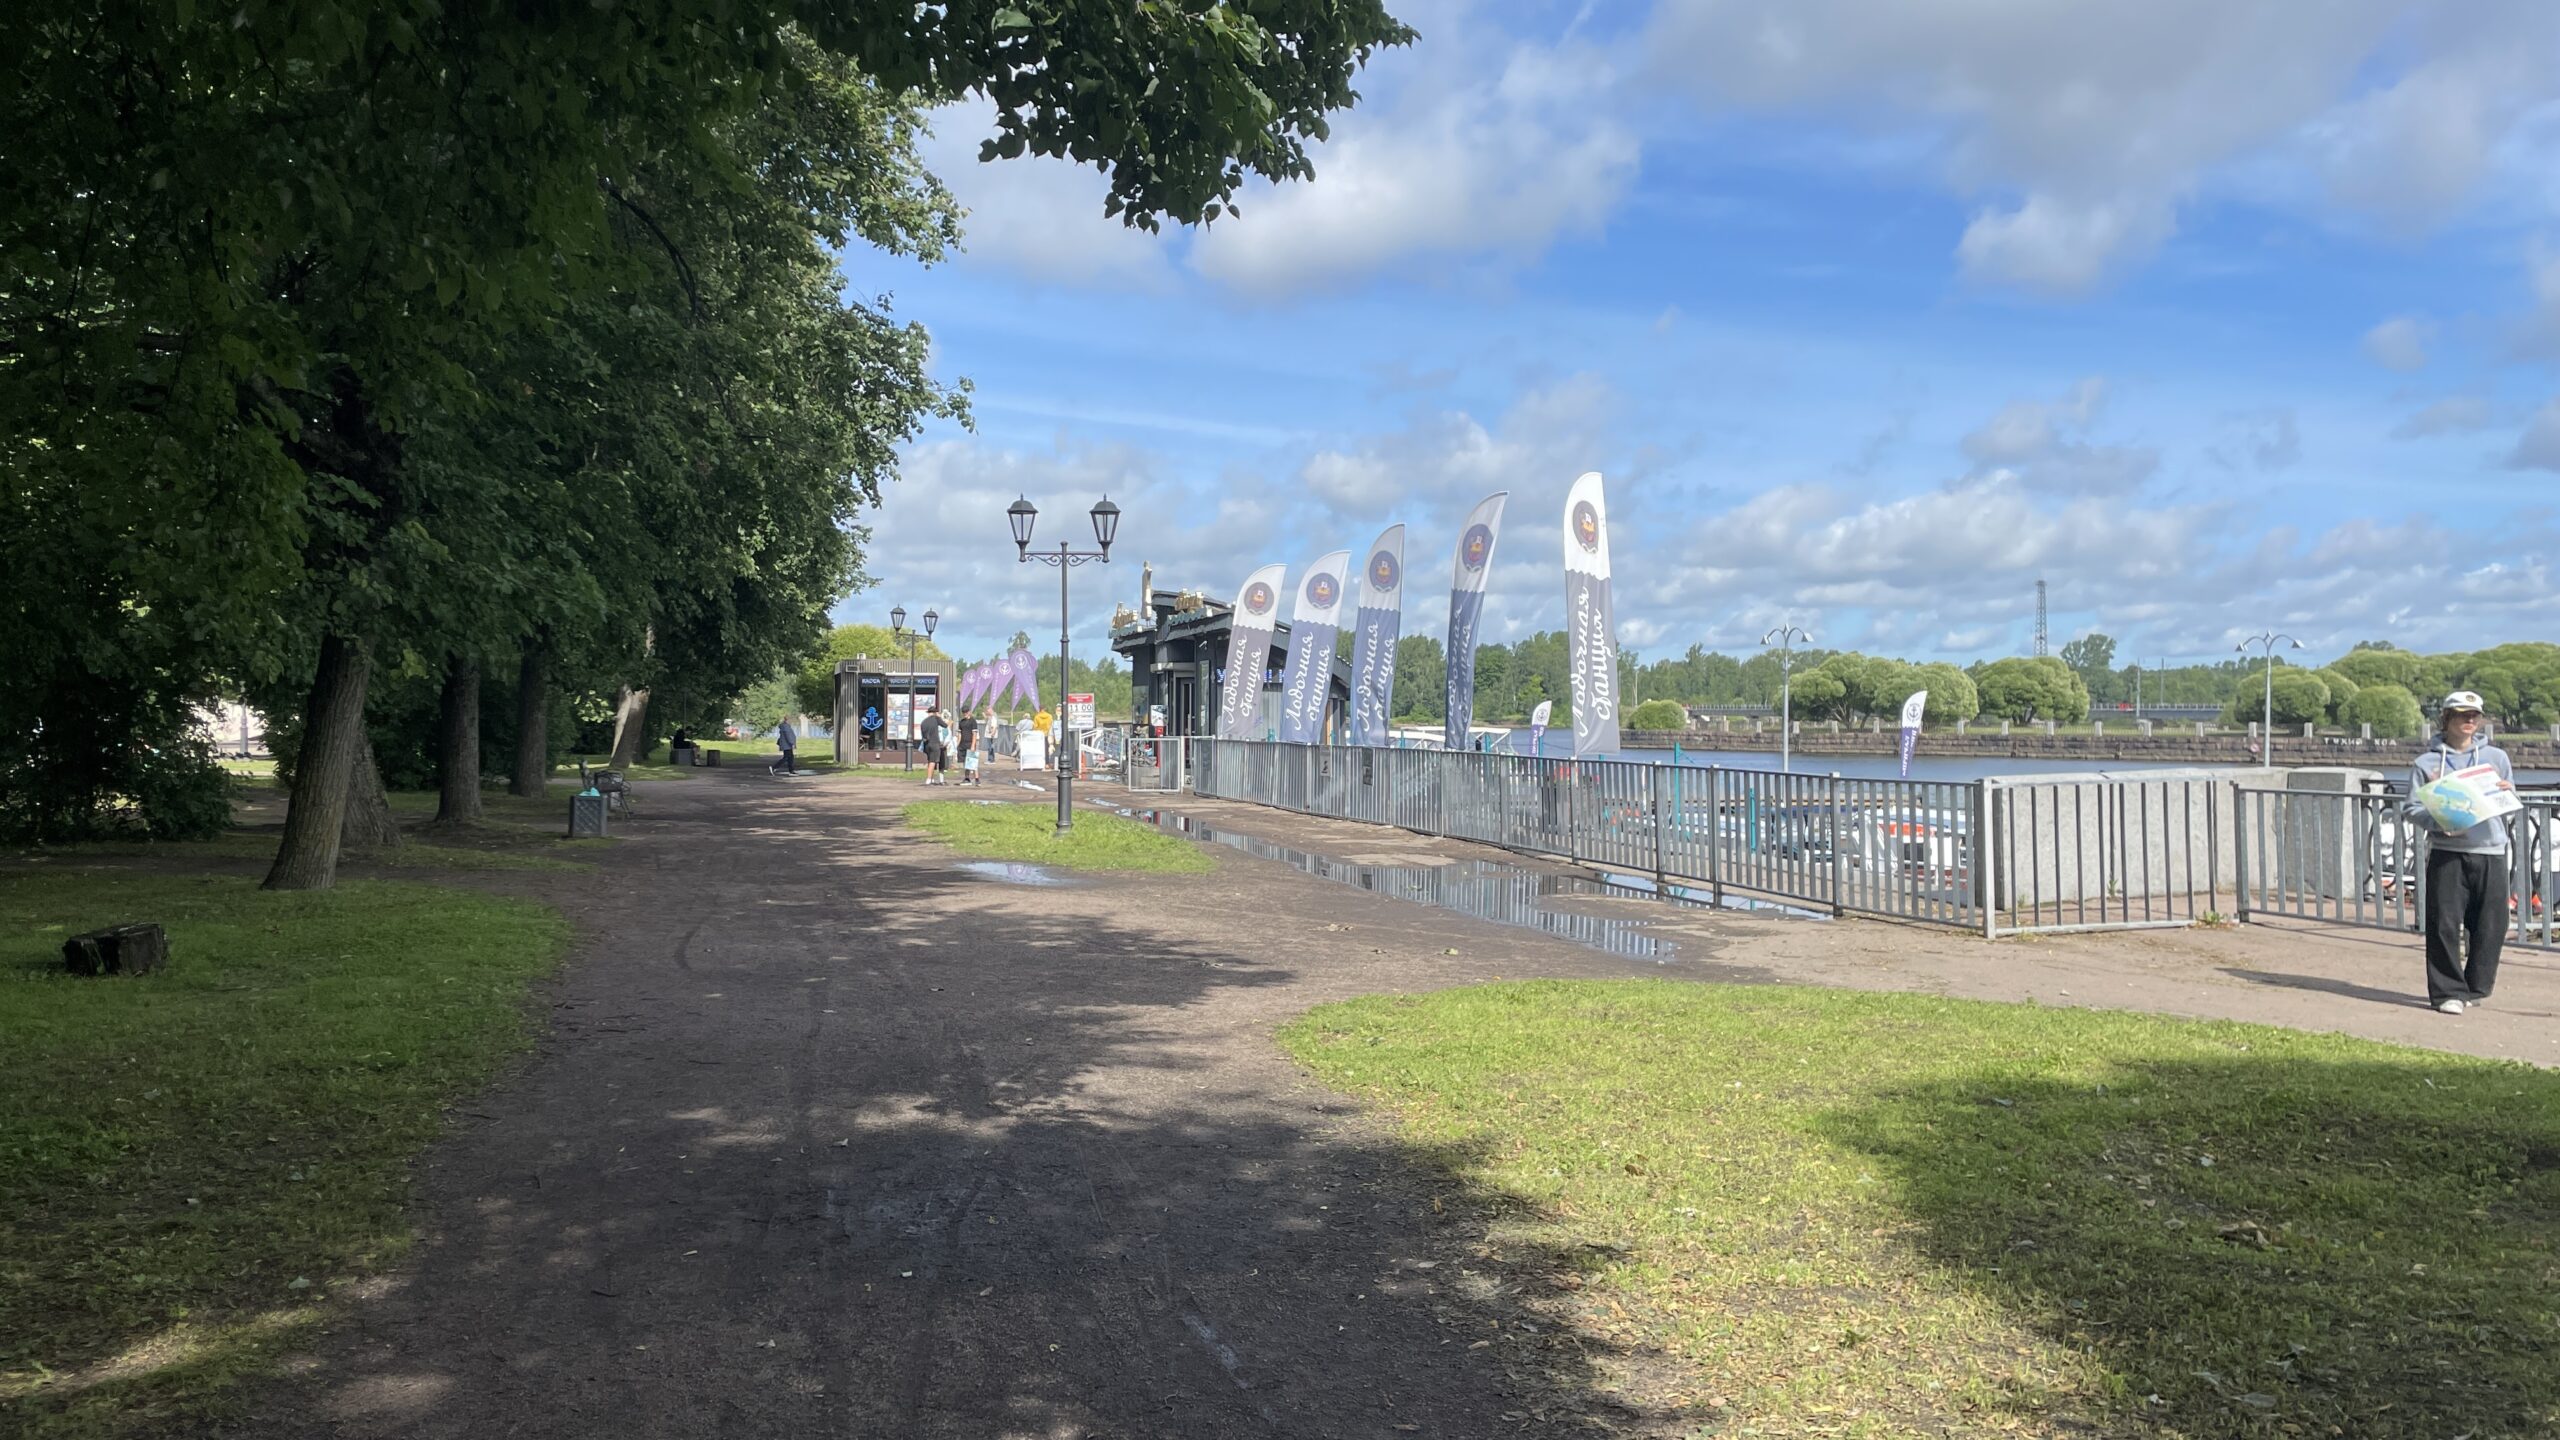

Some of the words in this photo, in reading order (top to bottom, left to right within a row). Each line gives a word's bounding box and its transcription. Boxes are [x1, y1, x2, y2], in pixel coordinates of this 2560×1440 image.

[1222, 635, 1248, 725] Лодочная
[1285, 631, 1314, 731] Лодочная
[1356, 619, 1379, 732] Лодочная
[1571, 586, 1591, 738] Лодочная
